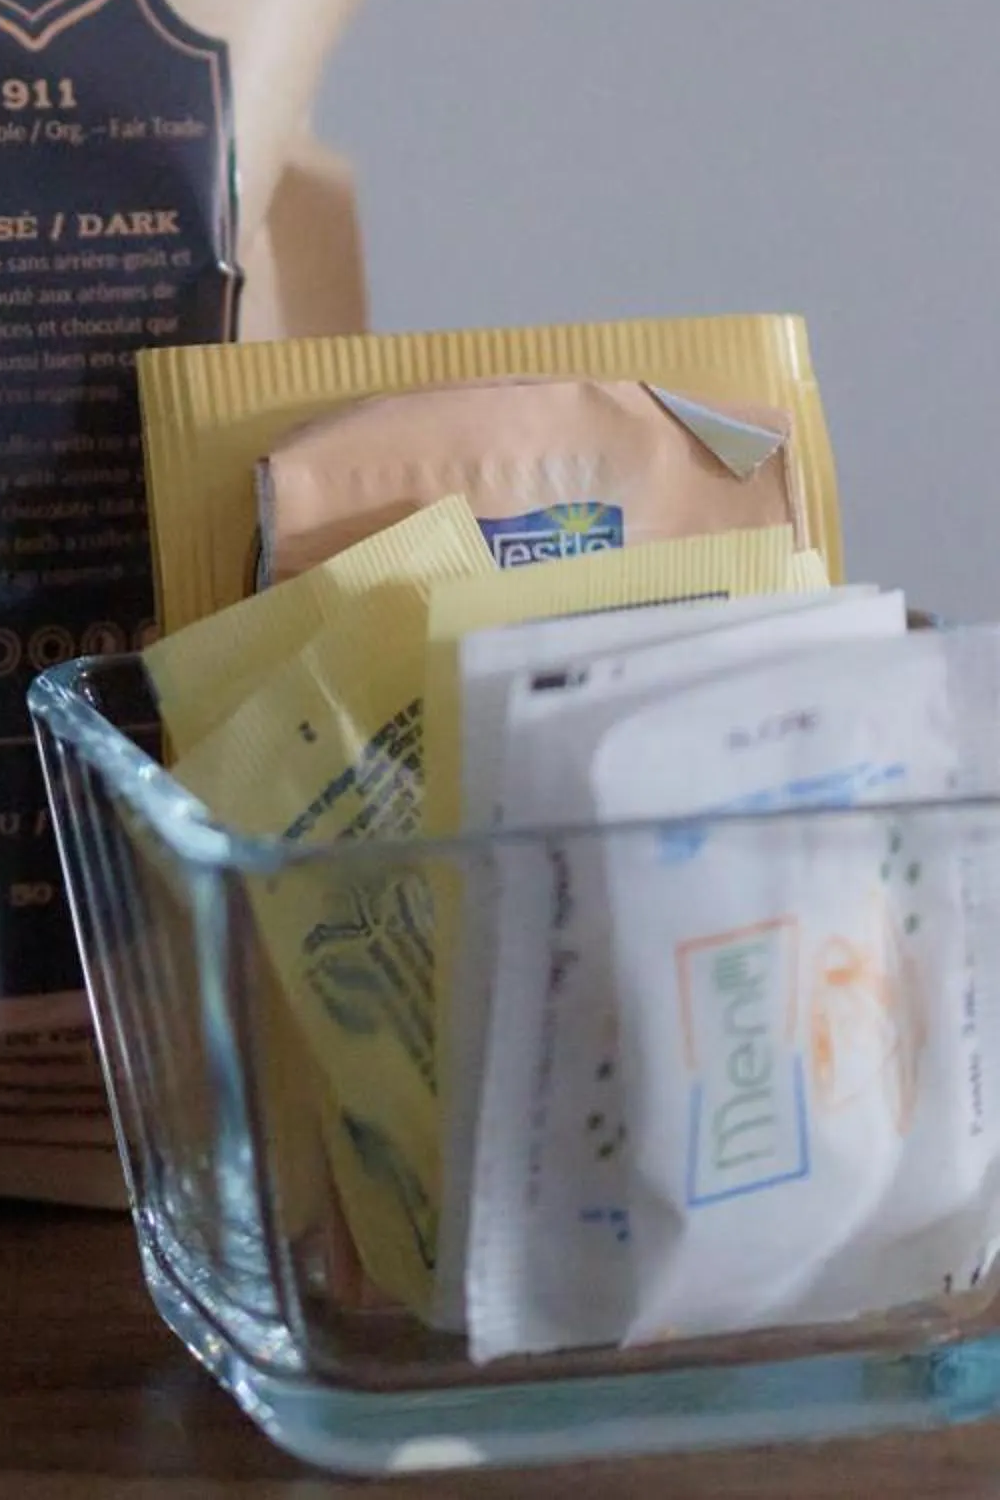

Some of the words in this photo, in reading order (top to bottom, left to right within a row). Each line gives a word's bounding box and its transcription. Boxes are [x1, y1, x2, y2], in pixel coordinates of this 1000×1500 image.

[1, 78, 78, 110] 911
[29, 118, 40, 145] /
[110, 118, 145, 140] Fair
[153, 115, 207, 139] Trade
[49, 212, 64, 242] /
[78, 210, 180, 238] DARK
[7, 255, 50, 273] sans
[171, 248, 192, 268] et
[152, 282, 177, 300] de
[37, 319, 57, 337] et
[61, 315, 143, 337] chocolat
[90, 352, 114, 368] en
